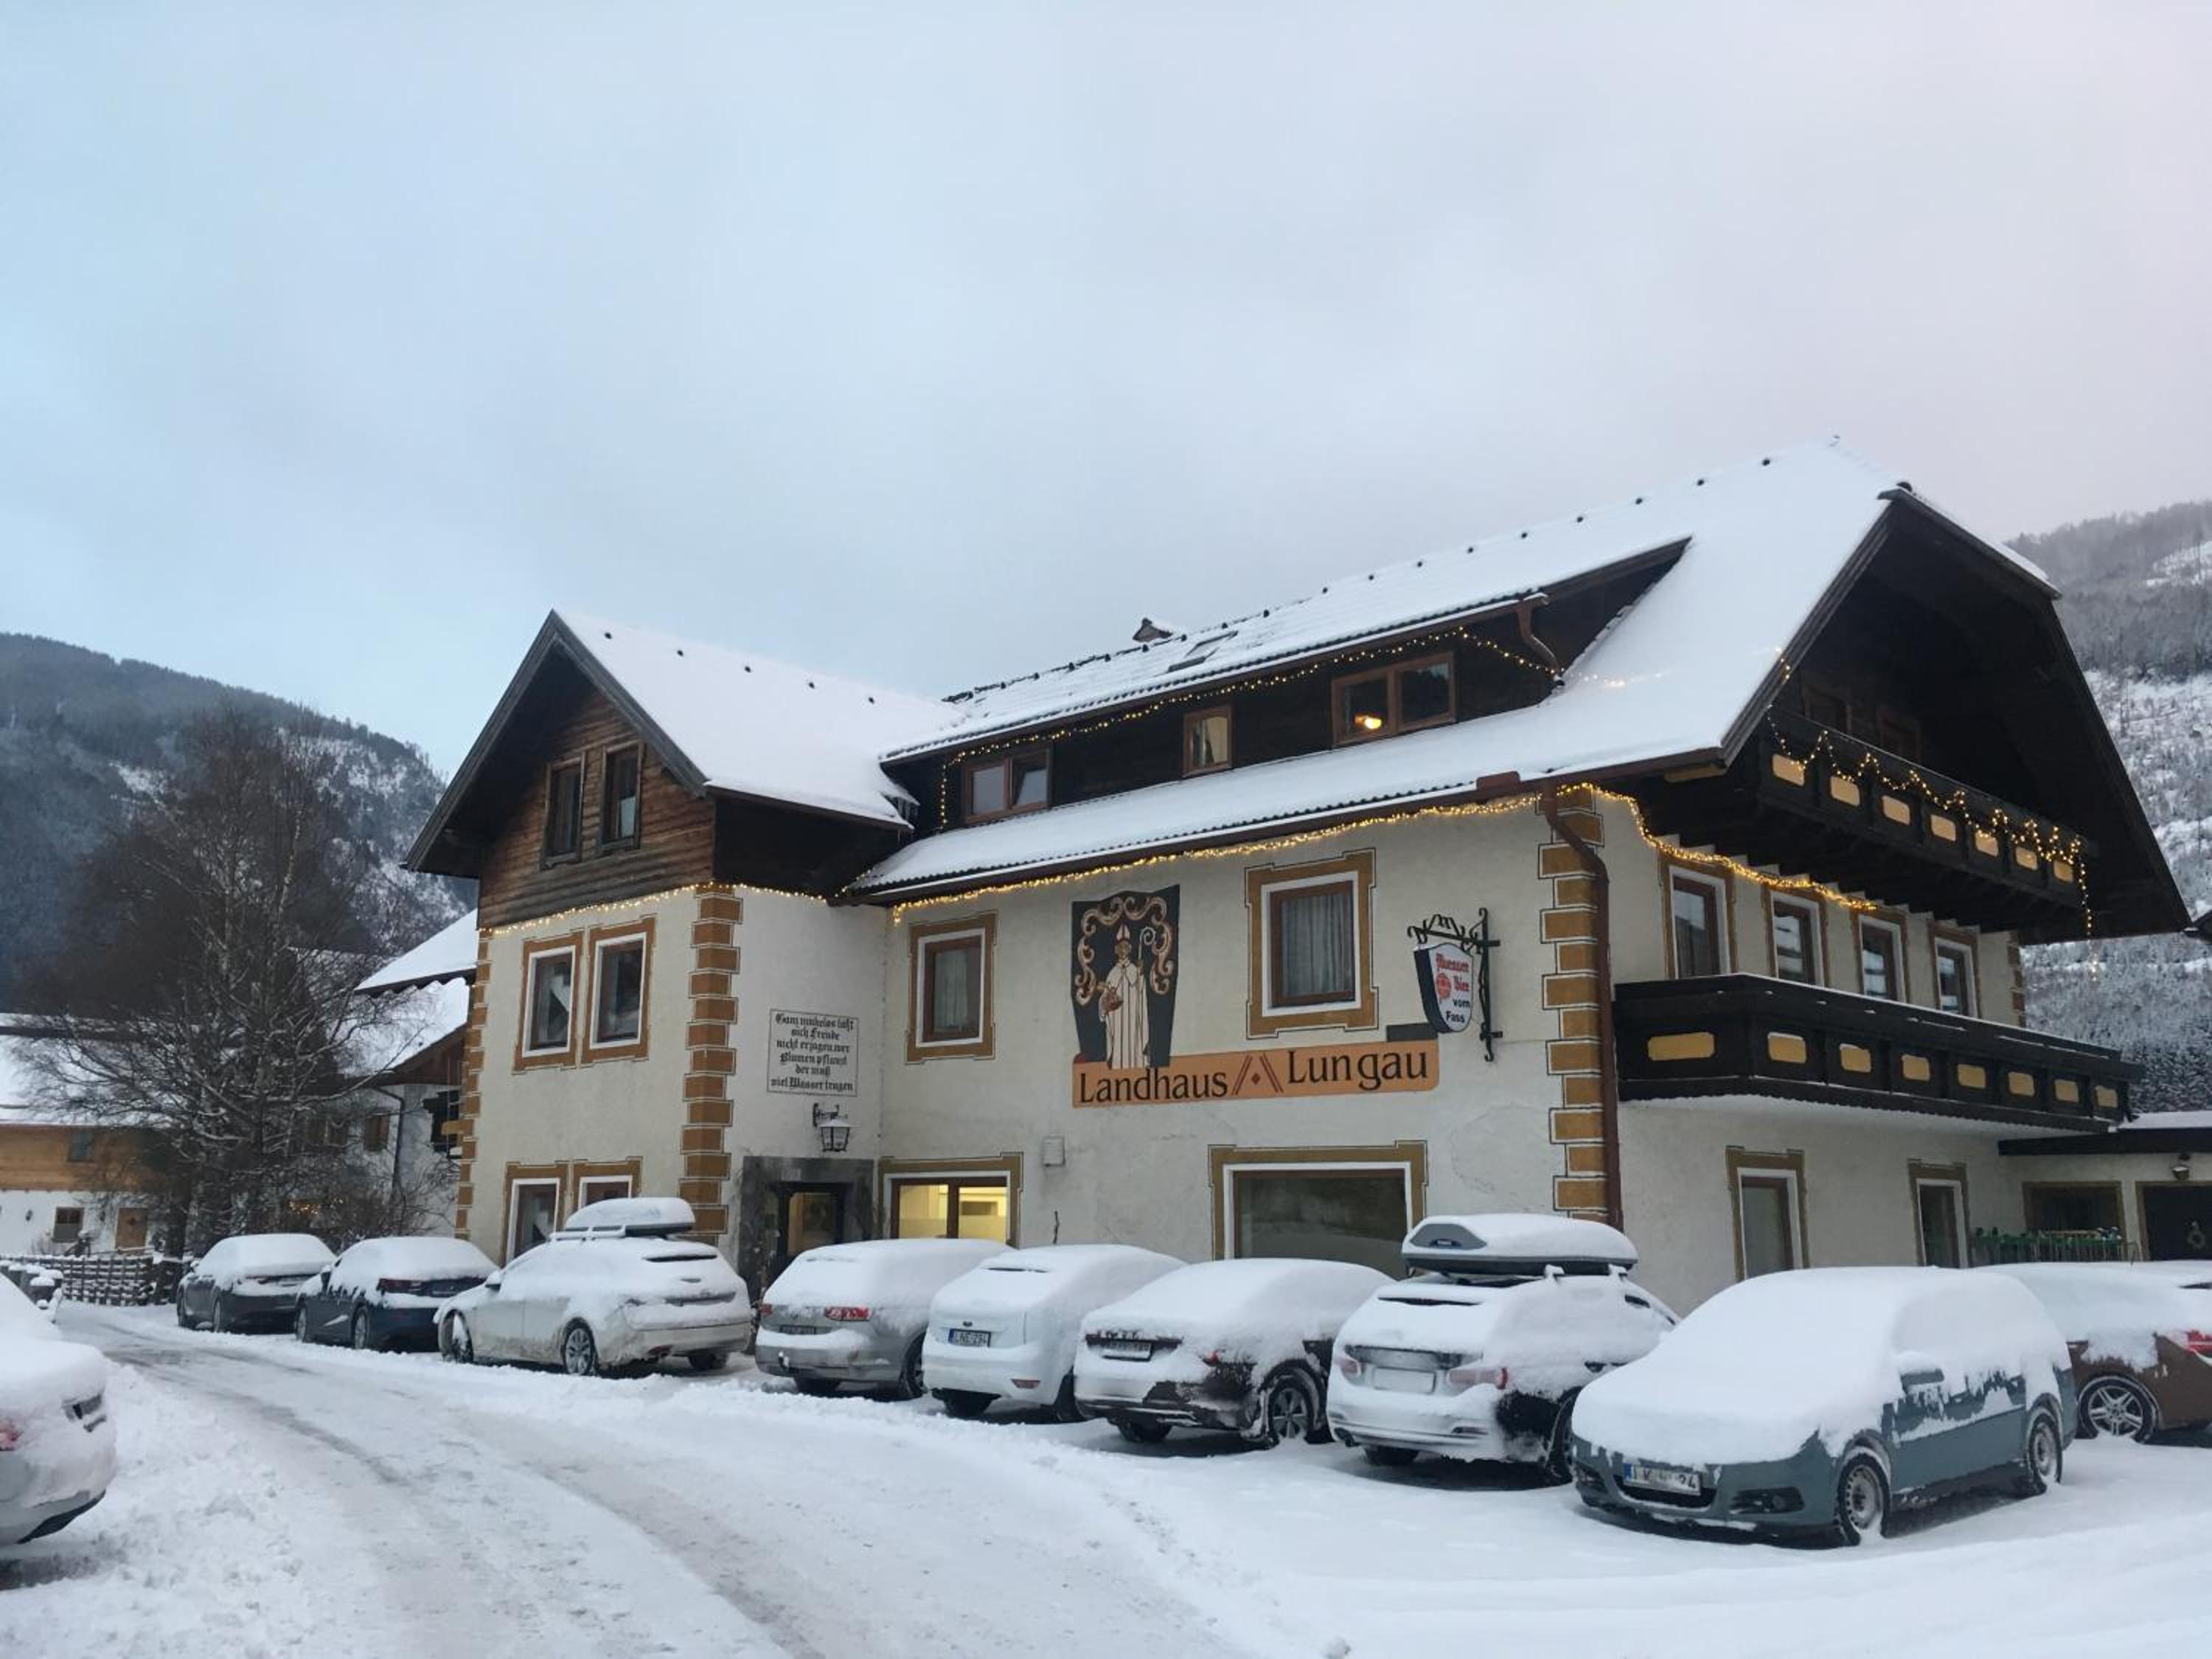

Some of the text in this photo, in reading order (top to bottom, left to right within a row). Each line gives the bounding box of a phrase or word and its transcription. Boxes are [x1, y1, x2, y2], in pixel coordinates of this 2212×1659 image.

[1452, 998, 1471, 1008] vom
[1446, 1011, 1464, 1023] Fass
[1080, 1050, 1427, 1103] Landhaus Lungau
